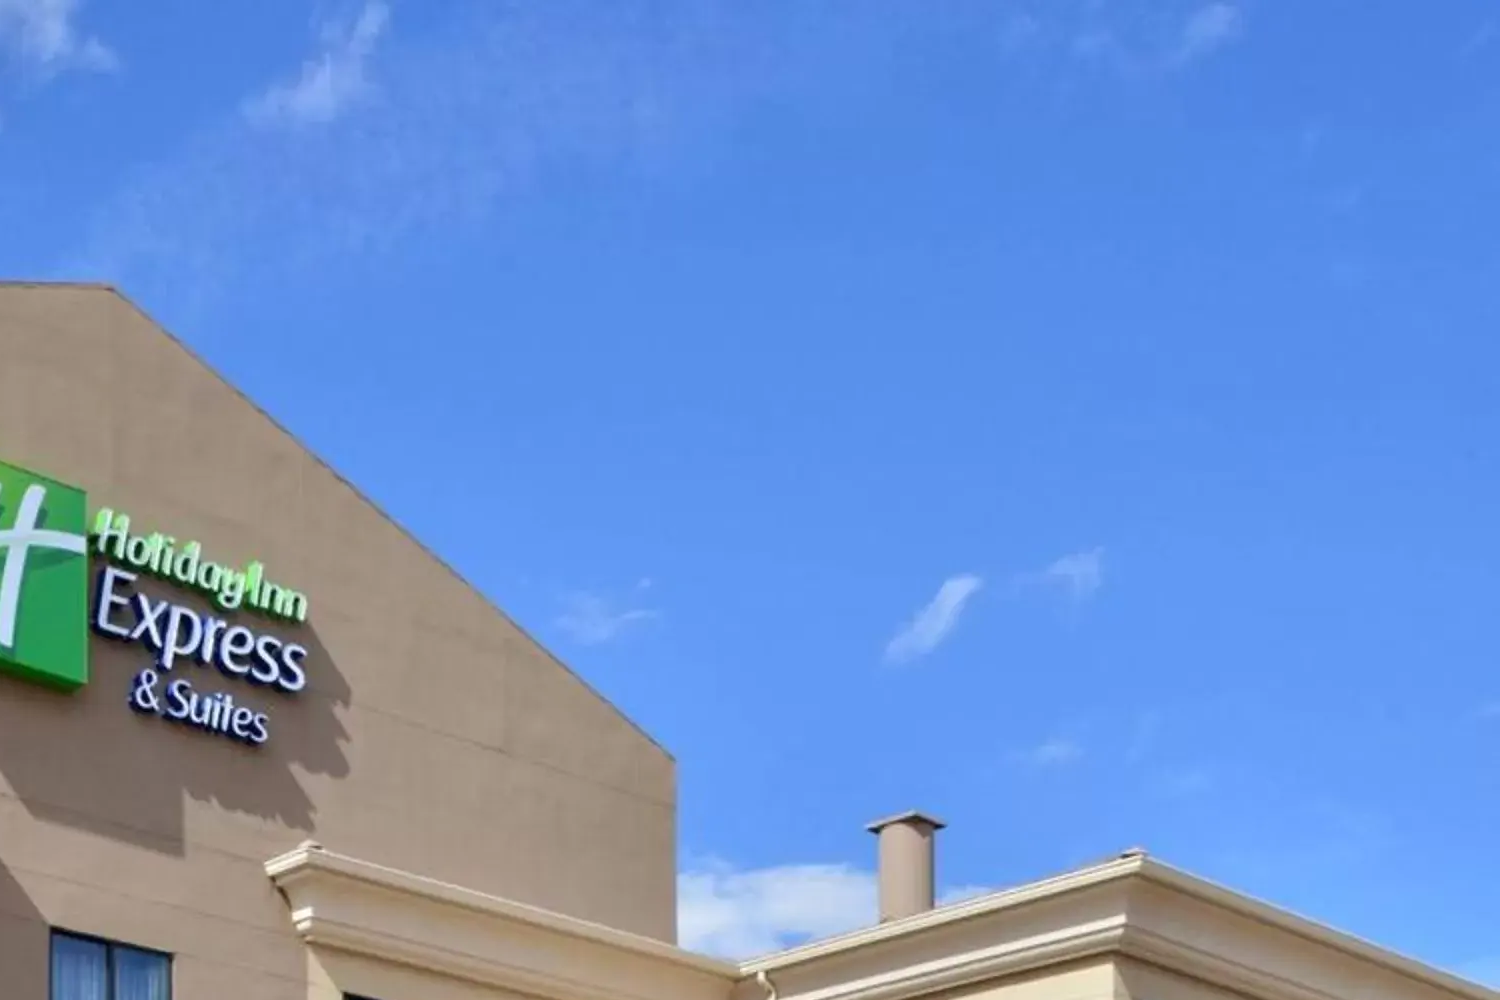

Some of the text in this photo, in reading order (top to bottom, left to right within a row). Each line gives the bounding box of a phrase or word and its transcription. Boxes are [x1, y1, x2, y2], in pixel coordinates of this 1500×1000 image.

[95, 507, 308, 622] Holiday Inn
[97, 564, 308, 691] Express
[133, 668, 269, 743] & Suites
